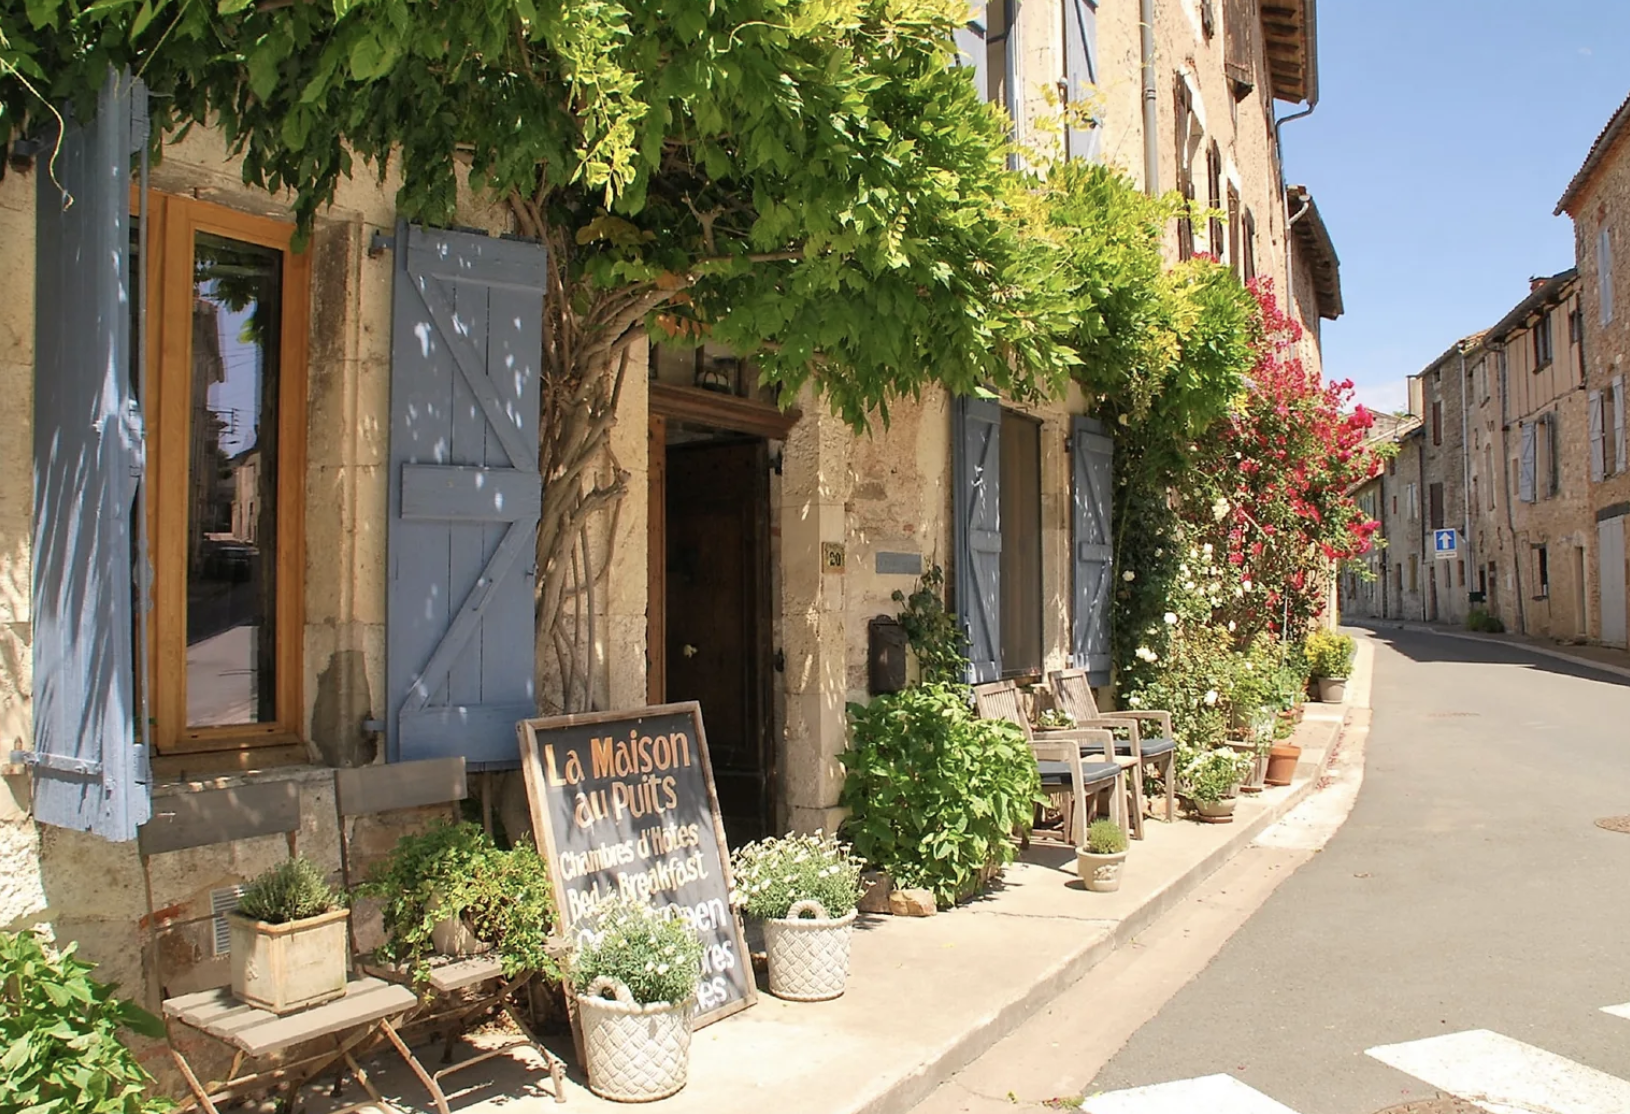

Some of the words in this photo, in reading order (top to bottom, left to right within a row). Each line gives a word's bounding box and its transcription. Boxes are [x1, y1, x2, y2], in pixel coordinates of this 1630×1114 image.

[829, 551, 841, 566] 20
[544, 743, 585, 787] La
[591, 729, 691, 779] Maison
[574, 789, 609, 828] au
[612, 774, 677, 820] Puits
[559, 840, 634, 881] Chambres
[567, 881, 600, 920] Bed
[617, 850, 709, 903] Breakfast
